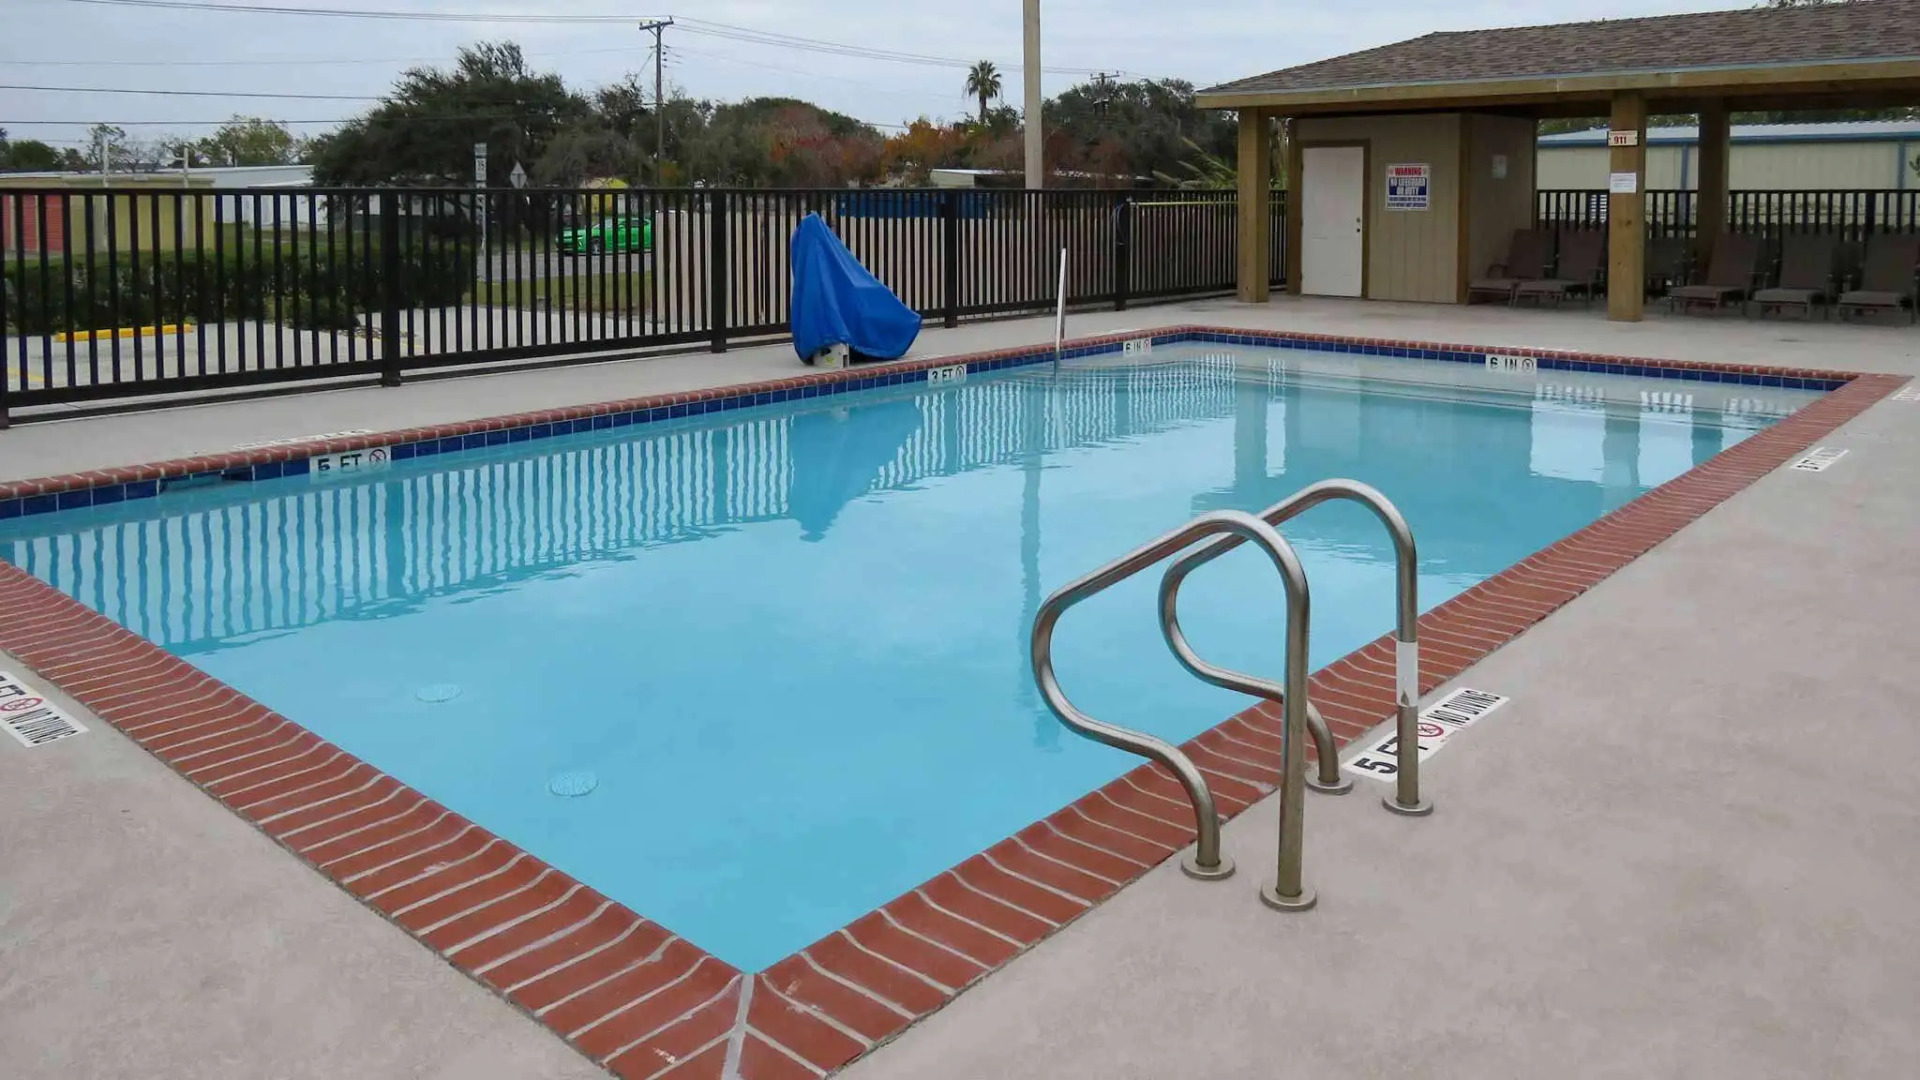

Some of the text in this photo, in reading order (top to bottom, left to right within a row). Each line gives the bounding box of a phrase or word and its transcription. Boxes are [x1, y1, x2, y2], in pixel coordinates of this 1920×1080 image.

[1613, 136, 1627, 144] 911
[1395, 167, 1422, 176] WARNING
[1504, 358, 1518, 370] IN
[317, 453, 362, 472] 5 FT
[3, 707, 53, 725] NO
[1425, 689, 1501, 726] NO DIVING
[1353, 757, 1398, 775] 5
